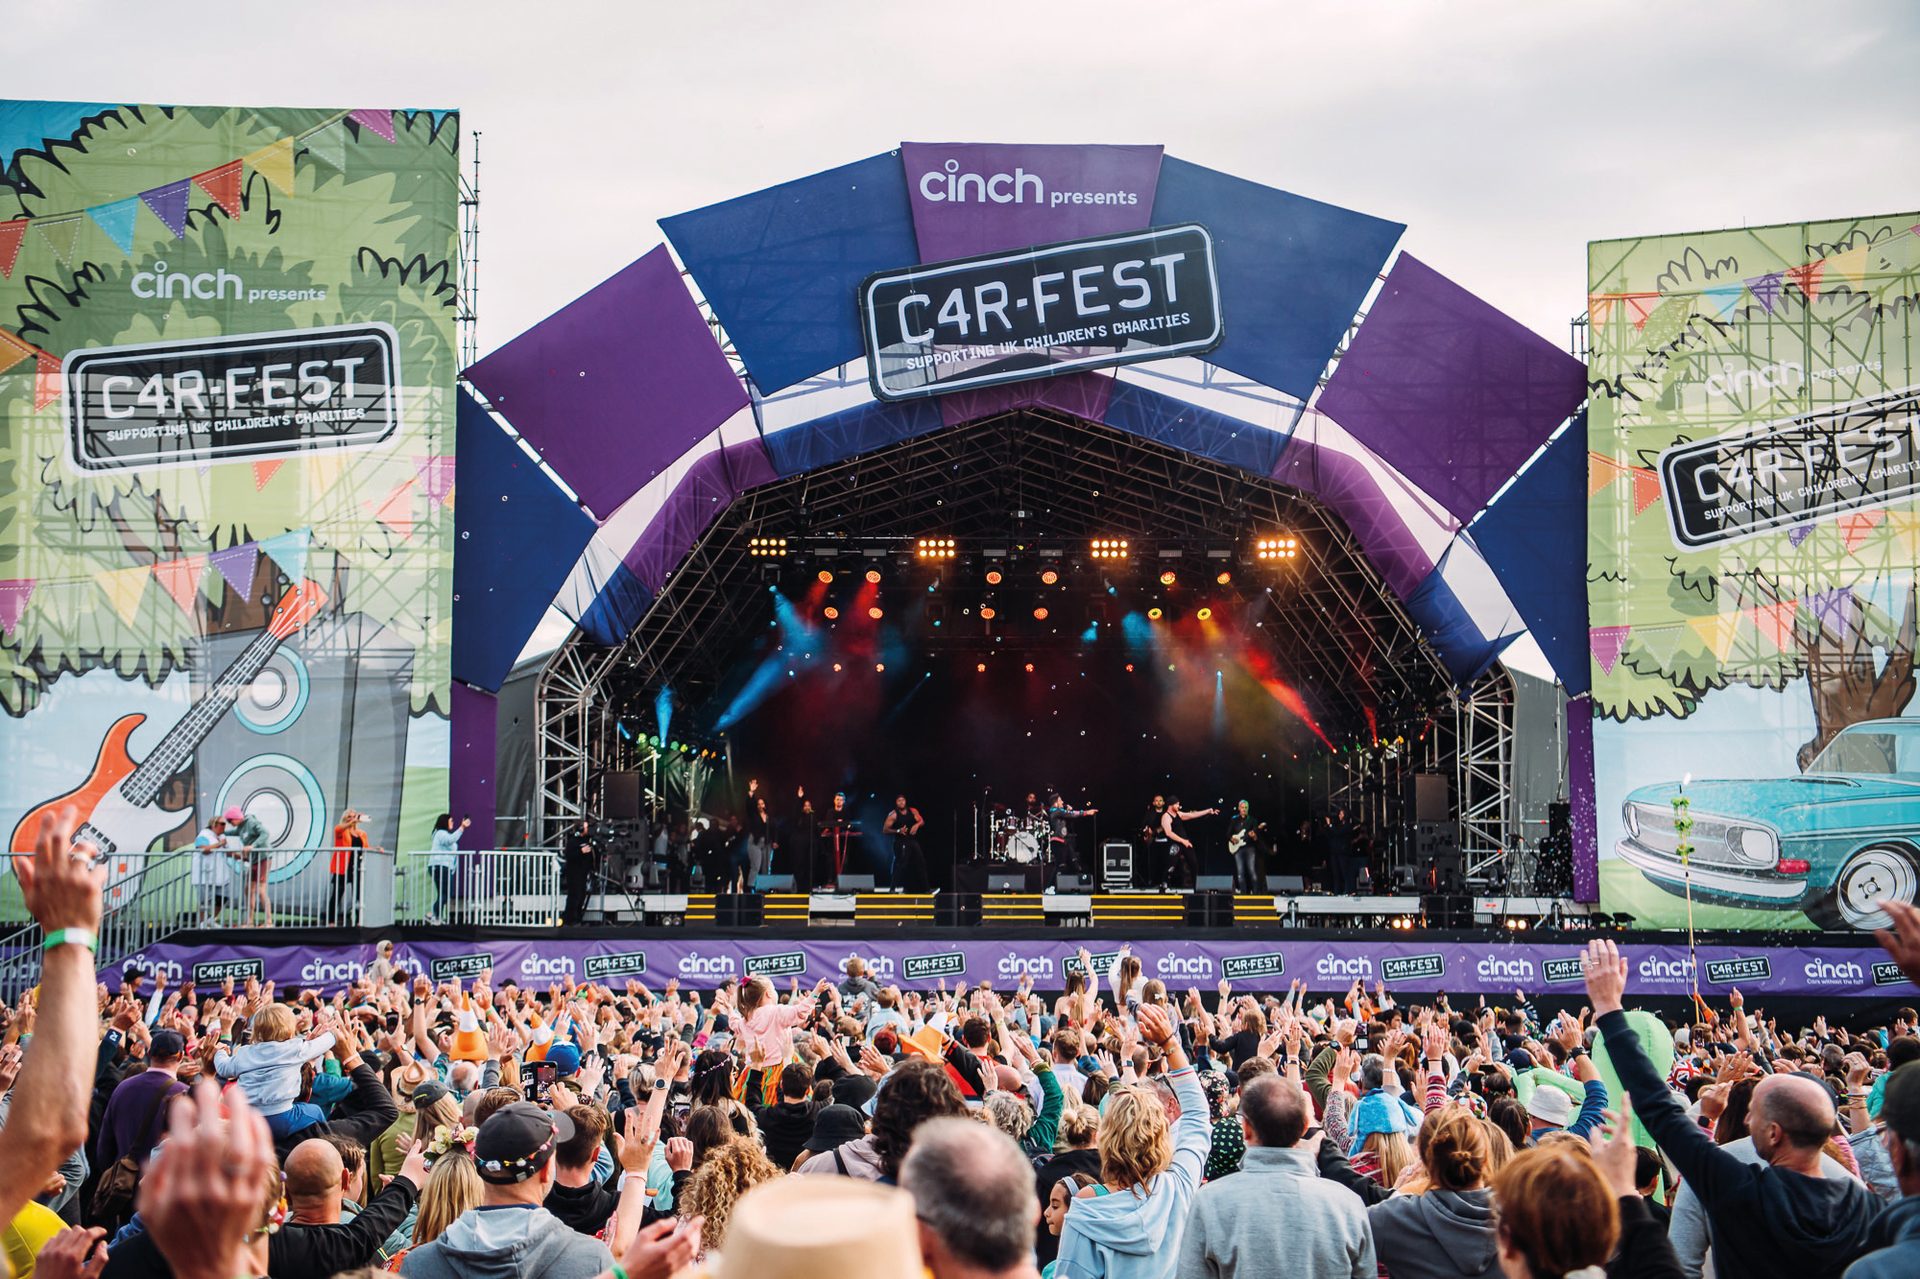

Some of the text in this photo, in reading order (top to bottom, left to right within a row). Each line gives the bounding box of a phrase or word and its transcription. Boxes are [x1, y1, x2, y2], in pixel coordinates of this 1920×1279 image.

[919, 158, 1138, 208] cinch presents
[131, 260, 326, 303] cinch presents
[907, 312, 1191, 370] SUPPORTING UK CHILDREN'S CHARITIES
[1704, 360, 1805, 397] cinch
[106, 408, 365, 441] SUPPORTING UK CHILDREN'S CHARITIES
[1704, 494, 1775, 520] SUPPORTING
[1778, 491, 1794, 502] UK
[1797, 473, 1867, 498] CHILDREN'S
[122, 953, 183, 979] cinch
[301, 957, 364, 981] cinch
[520, 952, 575, 974] cinch
[678, 951, 735, 972] cinch
[998, 952, 1053, 973] cinch
[1157, 951, 1212, 973] cinch
[1316, 953, 1373, 974] cinch
[1477, 954, 1534, 976] cinch
[1639, 955, 1695, 976] cinch
[1804, 957, 1864, 978] cinch
